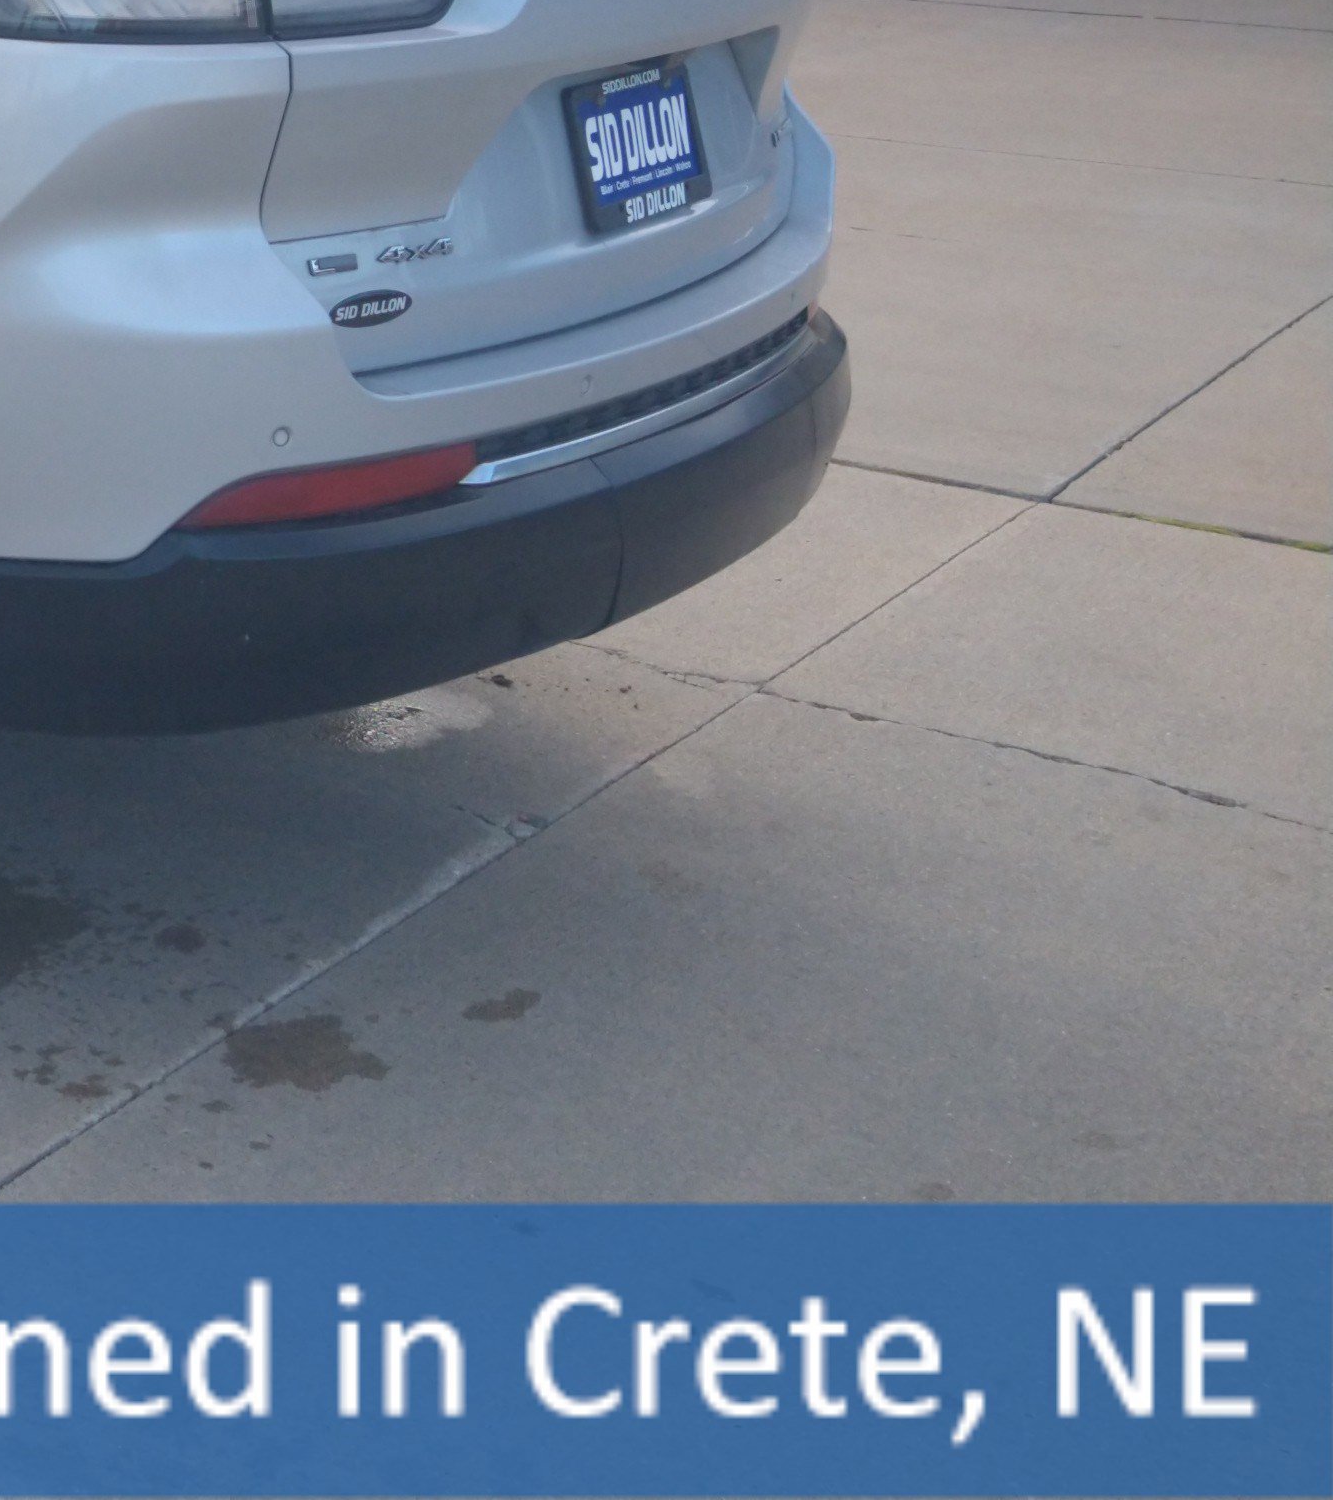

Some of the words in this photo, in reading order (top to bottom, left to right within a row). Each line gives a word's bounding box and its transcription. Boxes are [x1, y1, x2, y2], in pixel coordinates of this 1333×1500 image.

[601, 69, 660, 94] SIDDILLON.COM
[585, 113, 622, 181] SID
[621, 94, 690, 171] DILLON
[625, 196, 645, 223] SID
[646, 183, 686, 215] DILLON
[335, 305, 359, 322] SID
[360, 296, 407, 318] DILLON
